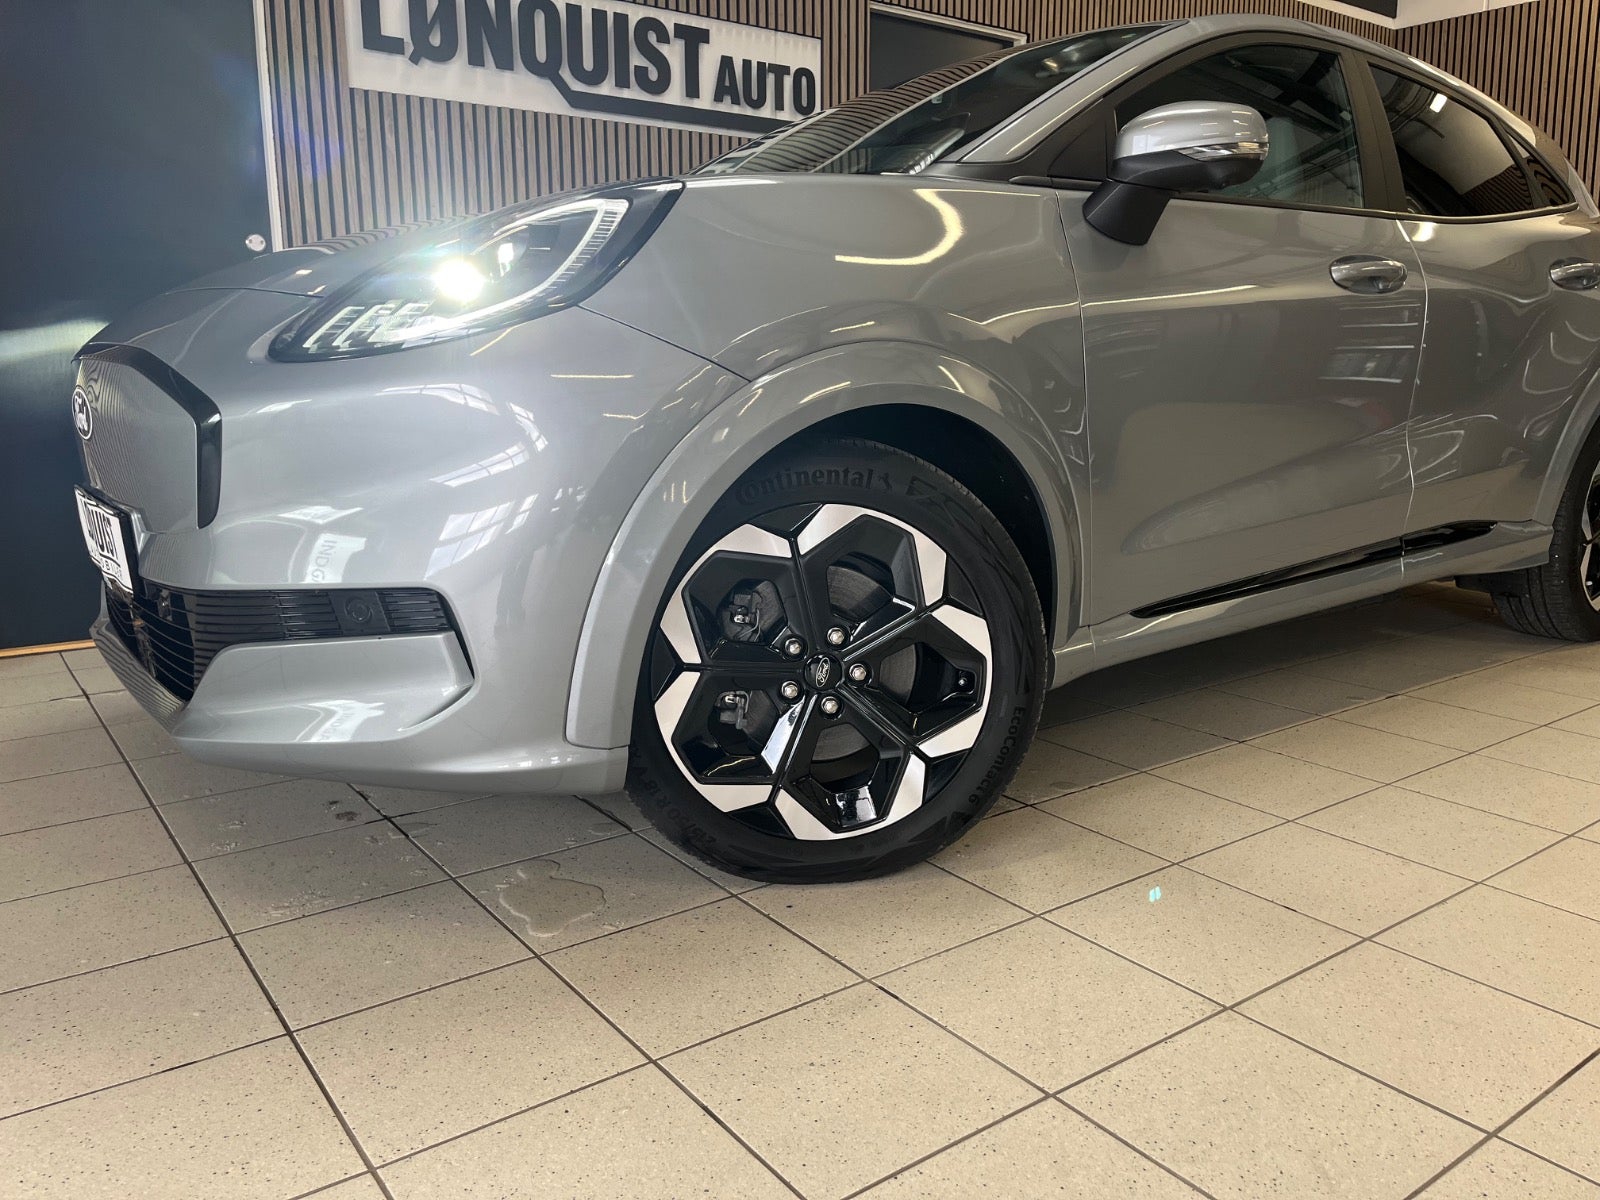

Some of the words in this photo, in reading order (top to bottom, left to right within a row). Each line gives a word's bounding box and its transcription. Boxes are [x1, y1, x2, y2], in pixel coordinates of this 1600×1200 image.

[360, 0, 711, 99] LØNQUIST
[714, 55, 816, 116] AUTO
[735, 466, 874, 505] Continental
[976, 706, 1026, 792] EcoContact
